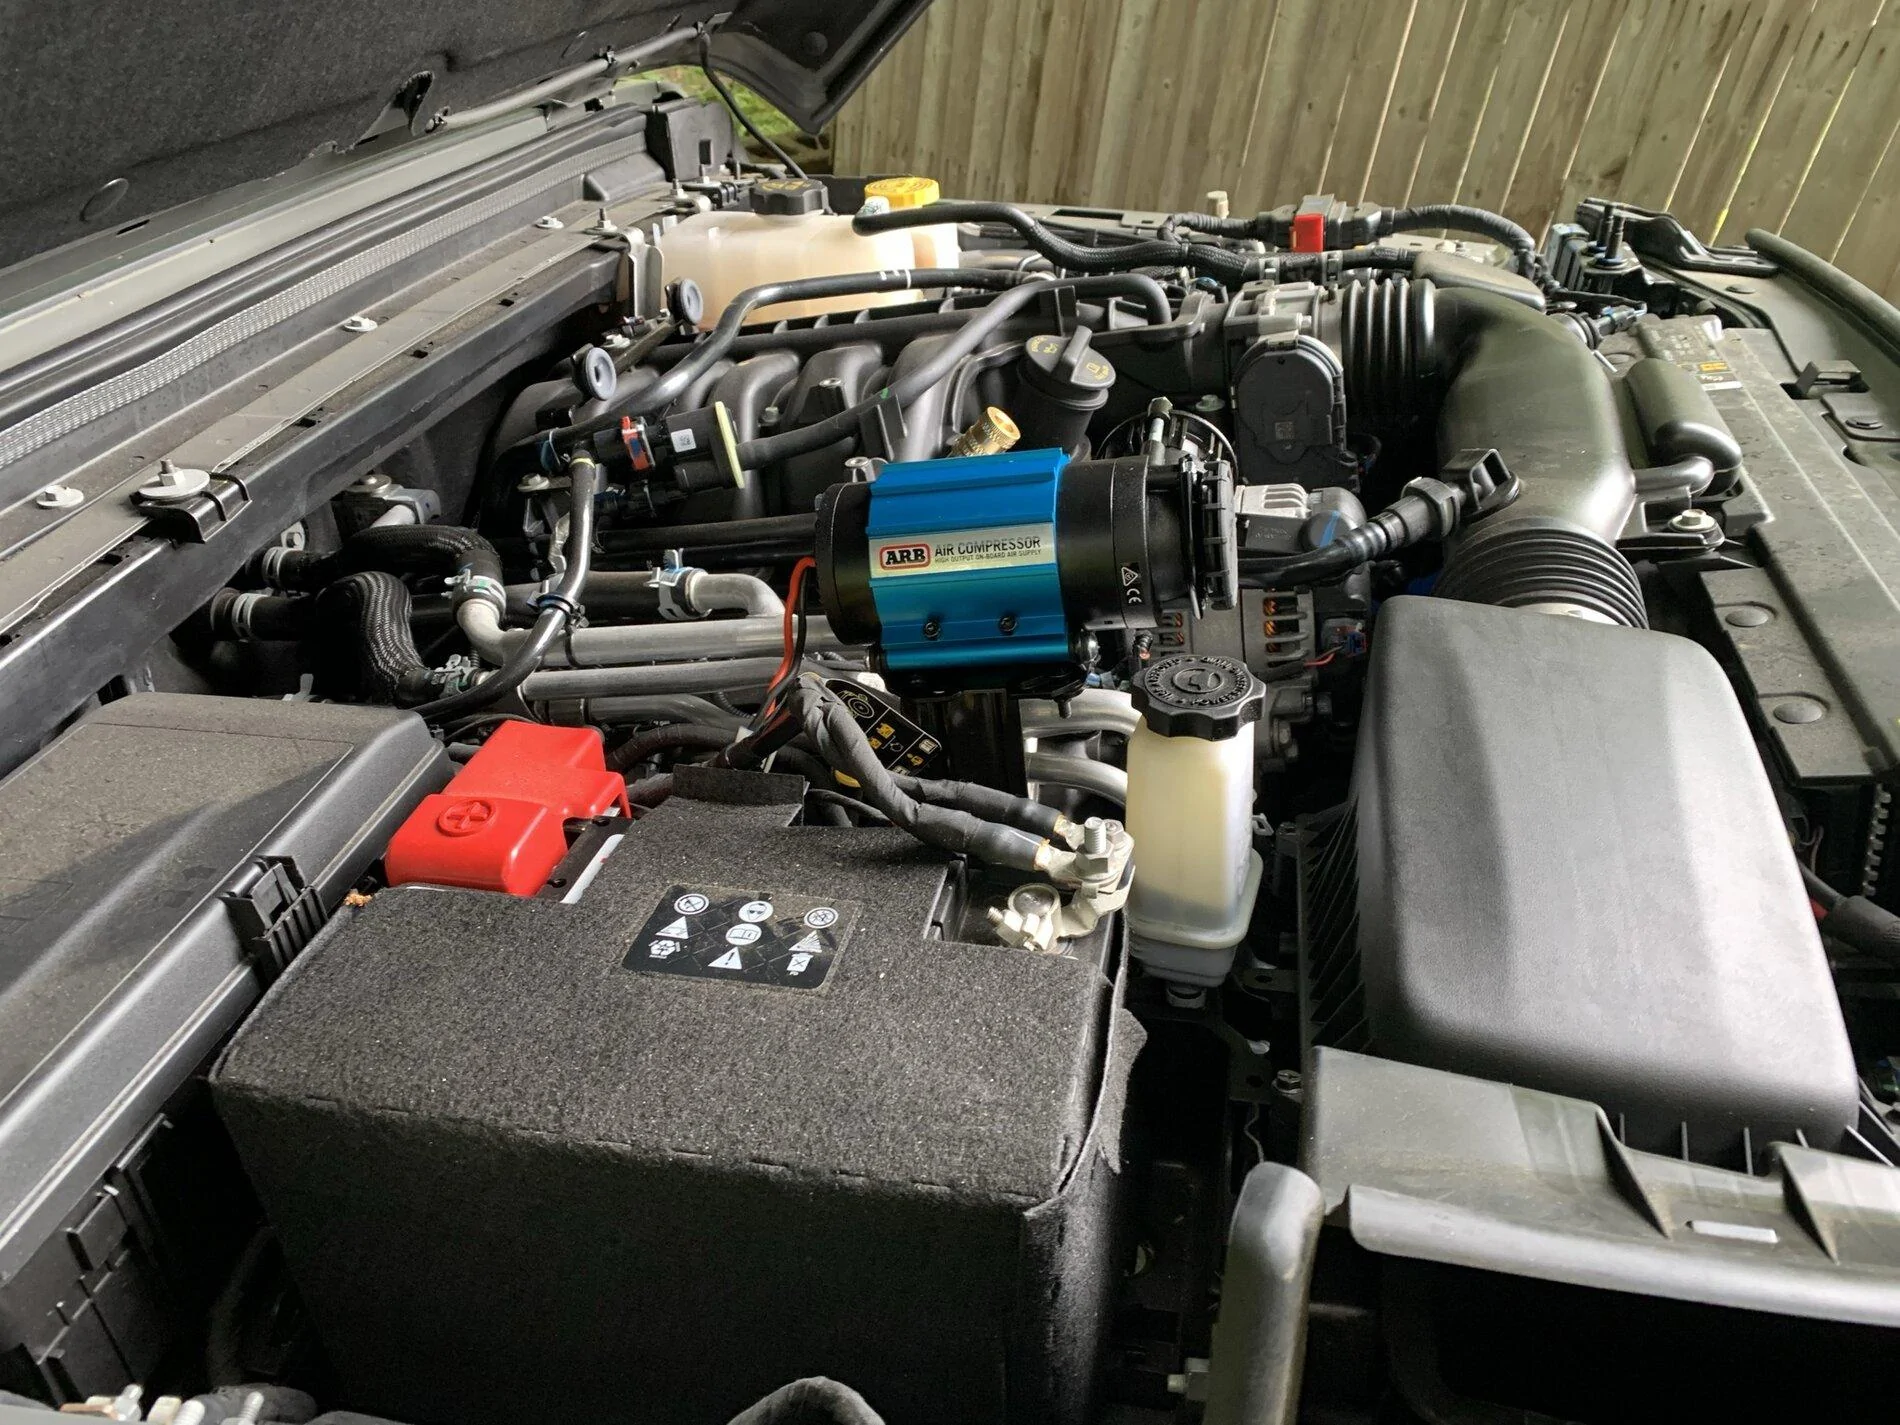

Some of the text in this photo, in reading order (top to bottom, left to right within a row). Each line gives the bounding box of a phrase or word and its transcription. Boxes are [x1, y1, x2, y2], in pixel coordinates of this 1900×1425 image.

[935, 535, 1041, 557] AIR COMPRESSOR
[885, 548, 926, 565] ARB
